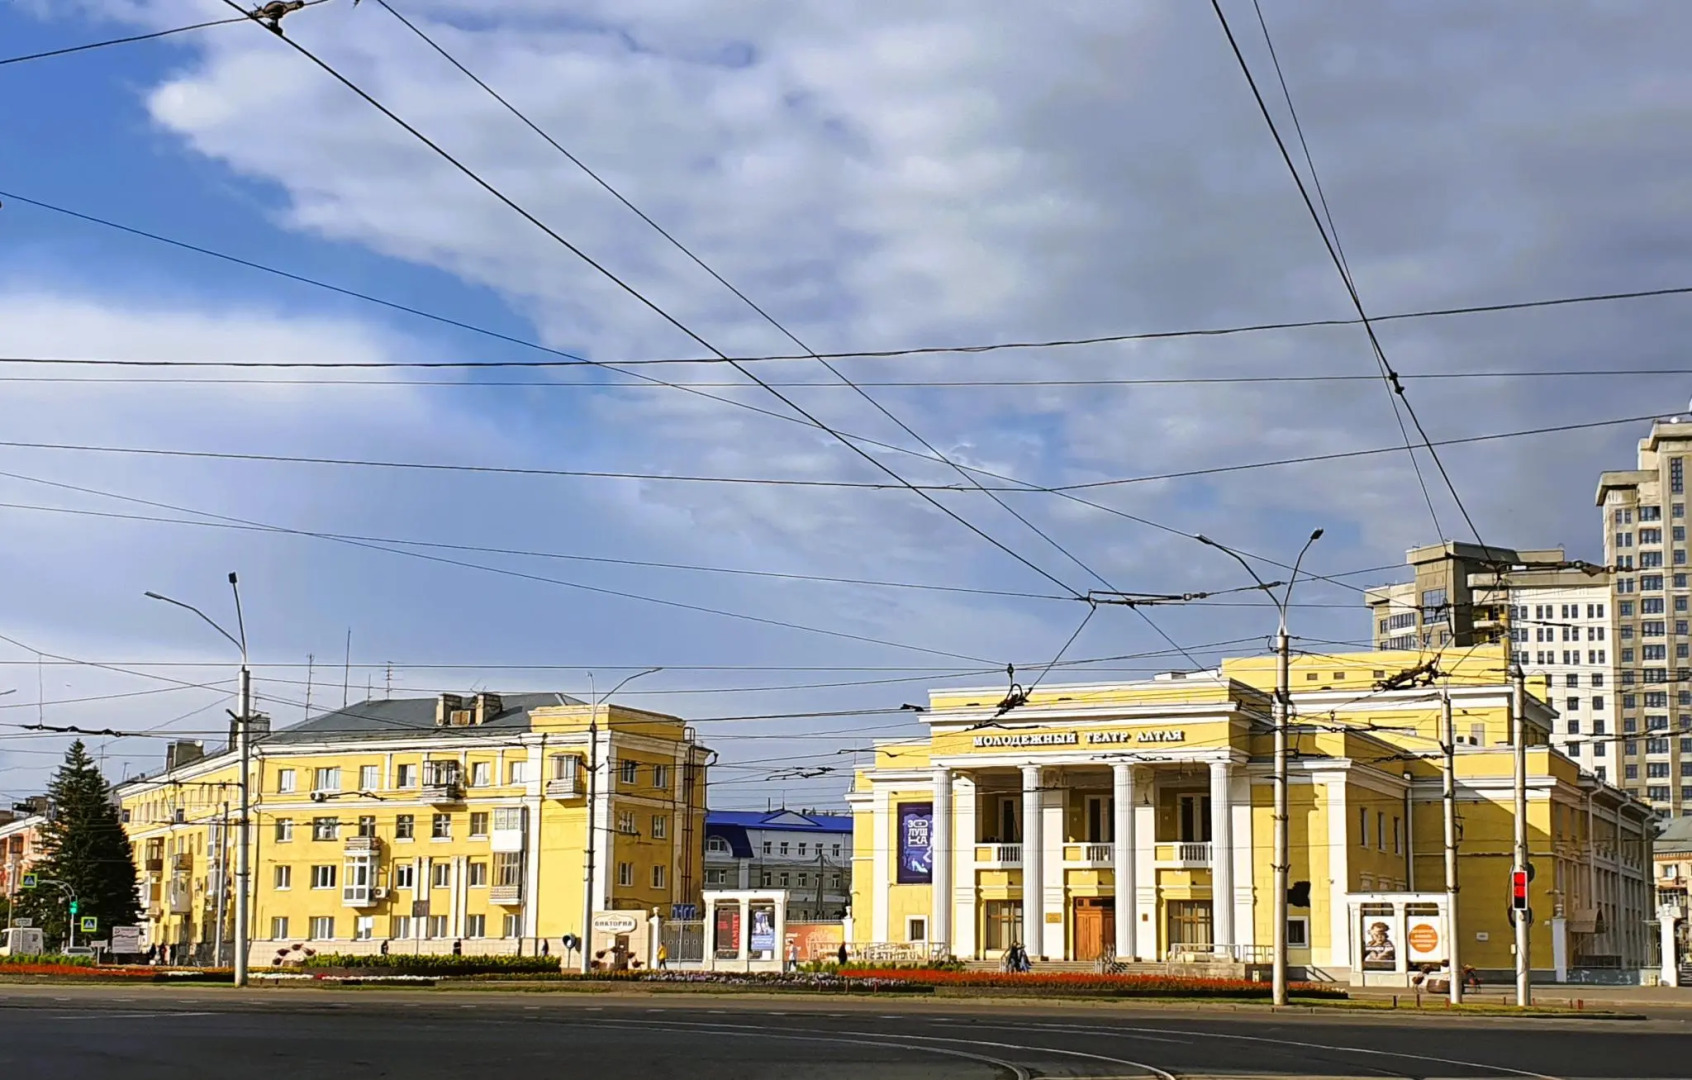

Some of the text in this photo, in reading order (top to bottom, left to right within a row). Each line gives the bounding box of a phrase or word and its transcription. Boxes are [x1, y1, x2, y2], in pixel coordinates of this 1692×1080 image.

[973, 730, 1184, 747] МОЛОДЕЖНЫЙ ТЕАТР АЛТАЯ
